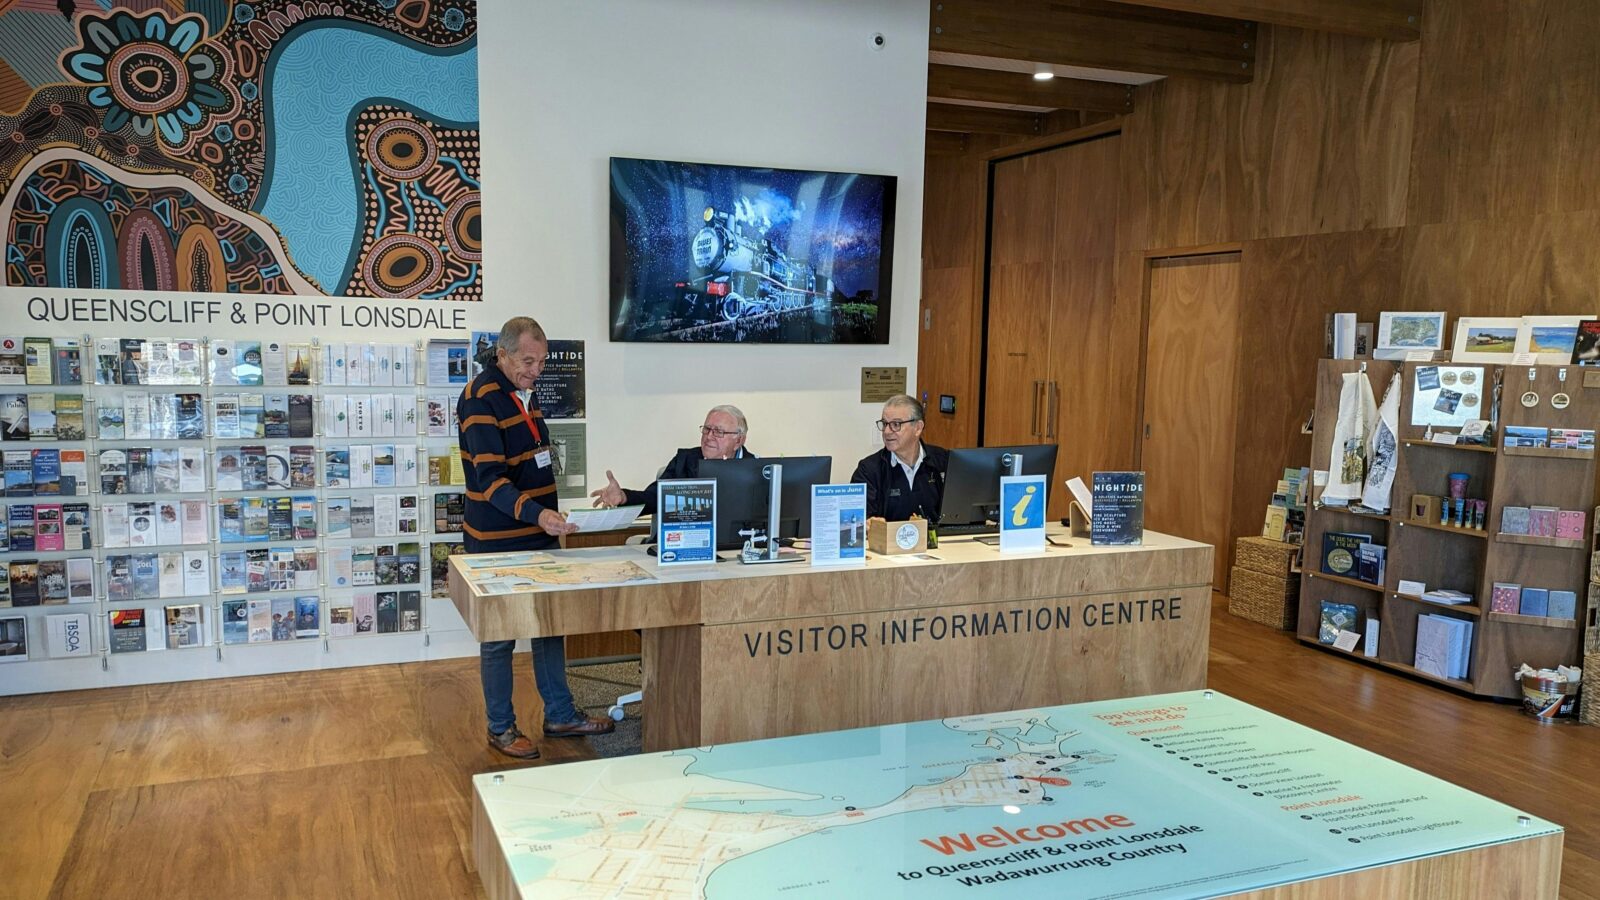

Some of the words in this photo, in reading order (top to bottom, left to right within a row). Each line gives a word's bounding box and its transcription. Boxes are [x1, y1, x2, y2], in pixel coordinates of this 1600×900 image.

[27, 296, 221, 323] QUEENSCLIFF
[230, 302, 247, 324] &
[255, 303, 332, 327] POINT
[341, 305, 467, 330] LONSDALE
[545, 351, 583, 360] GHTIDE
[67, 620, 80, 652] TBSOA
[744, 623, 869, 658] VISITOR
[880, 605, 1072, 646] INFORMATION
[1082, 597, 1183, 627] CENTRE
[1090, 713, 1123, 721] Top
[1122, 708, 1170, 717] things
[1136, 715, 1165, 723] and
[1280, 802, 1314, 811] Point
[1312, 795, 1363, 806] Lonsdale
[919, 814, 1136, 856] Welcome
[897, 871, 923, 881] to
[926, 848, 1042, 877] Queenscliff
[1043, 846, 1066, 856] &
[1065, 837, 1121, 852] Point
[1118, 824, 1204, 844] Lonsdale
[956, 856, 1112, 887] Wadawurrung
[1107, 843, 1187, 862] Country
